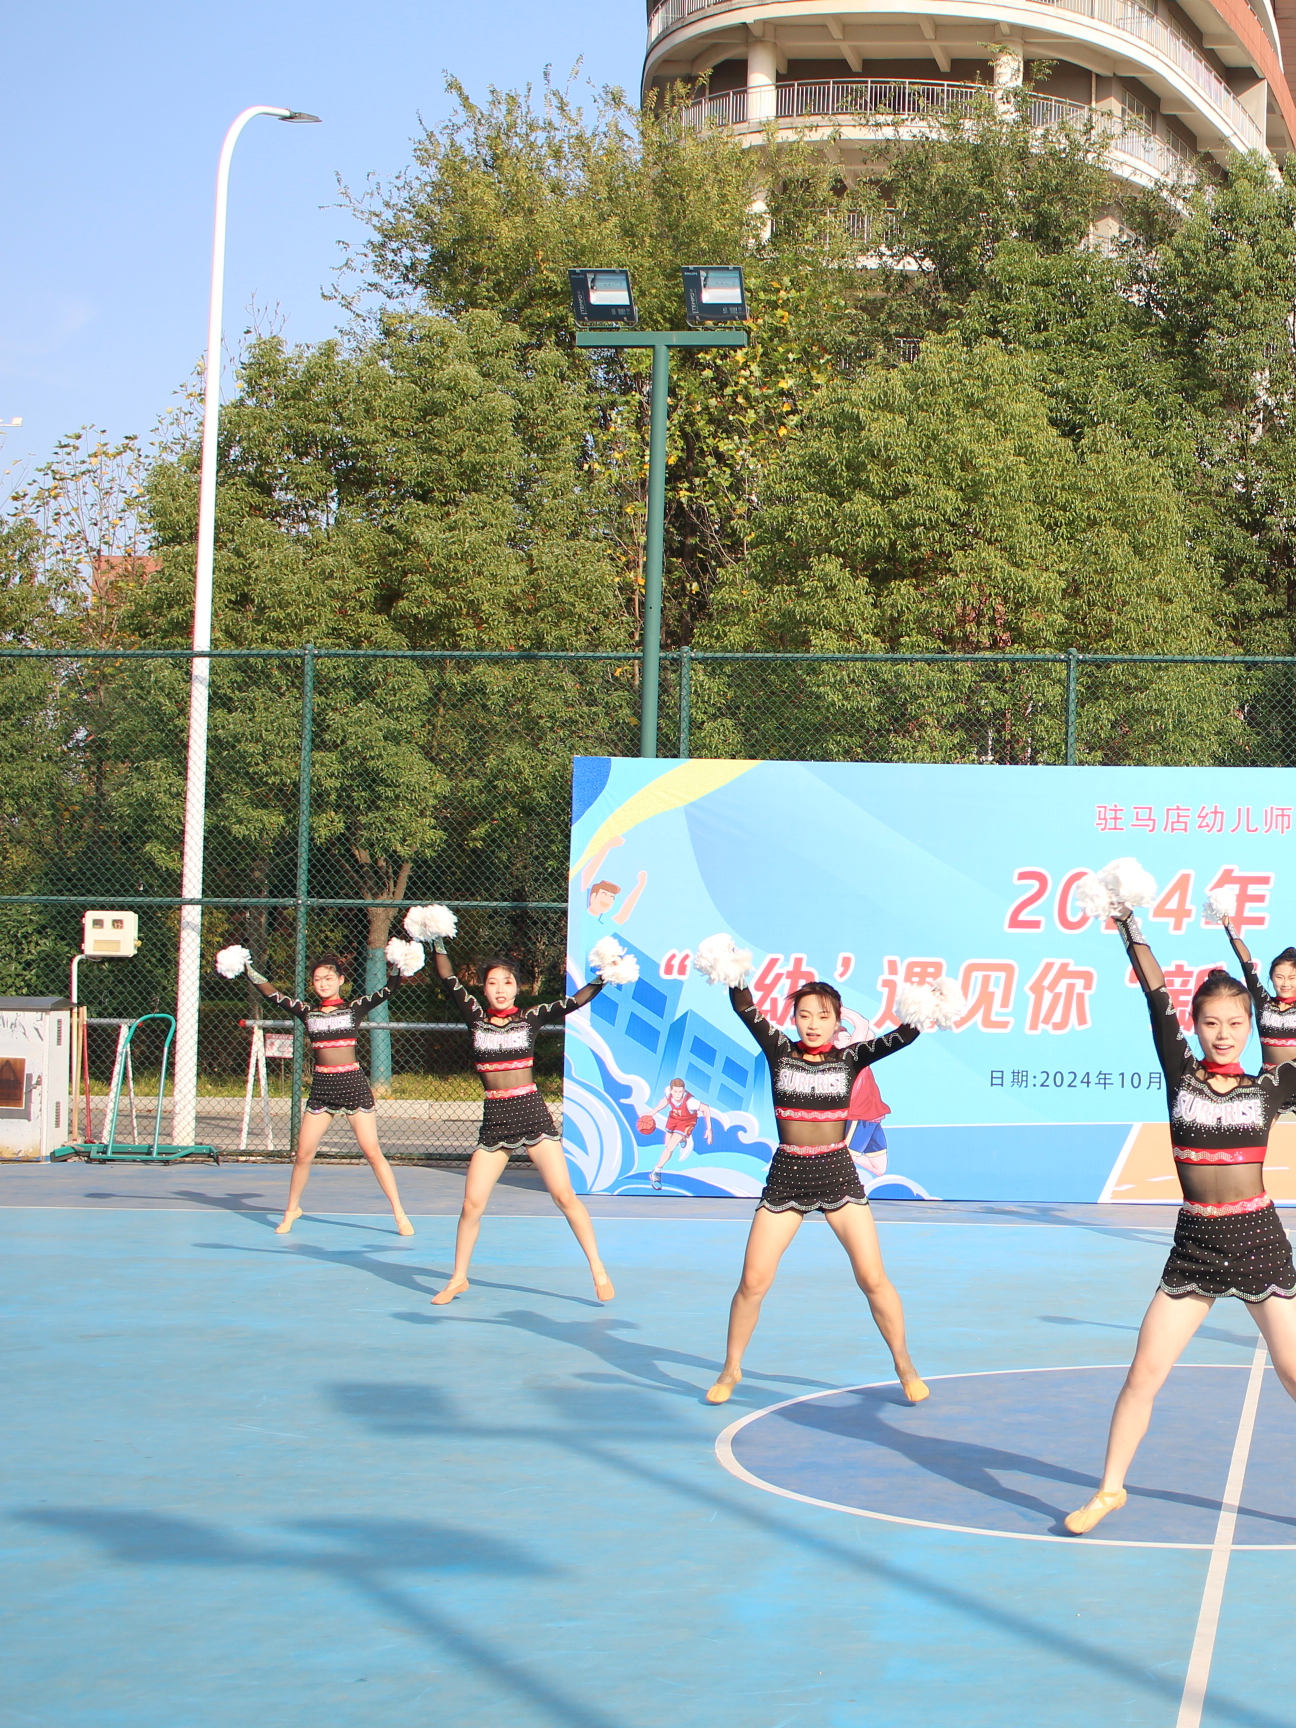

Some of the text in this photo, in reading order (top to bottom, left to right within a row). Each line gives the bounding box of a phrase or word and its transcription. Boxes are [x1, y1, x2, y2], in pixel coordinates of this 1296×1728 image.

[307, 1015, 352, 1032] SURPRISE
[474, 1030, 527, 1049] SURPRISE
[778, 1069, 847, 1093] SURPRISE
[1173, 1090, 1263, 1126] SURPRISE
